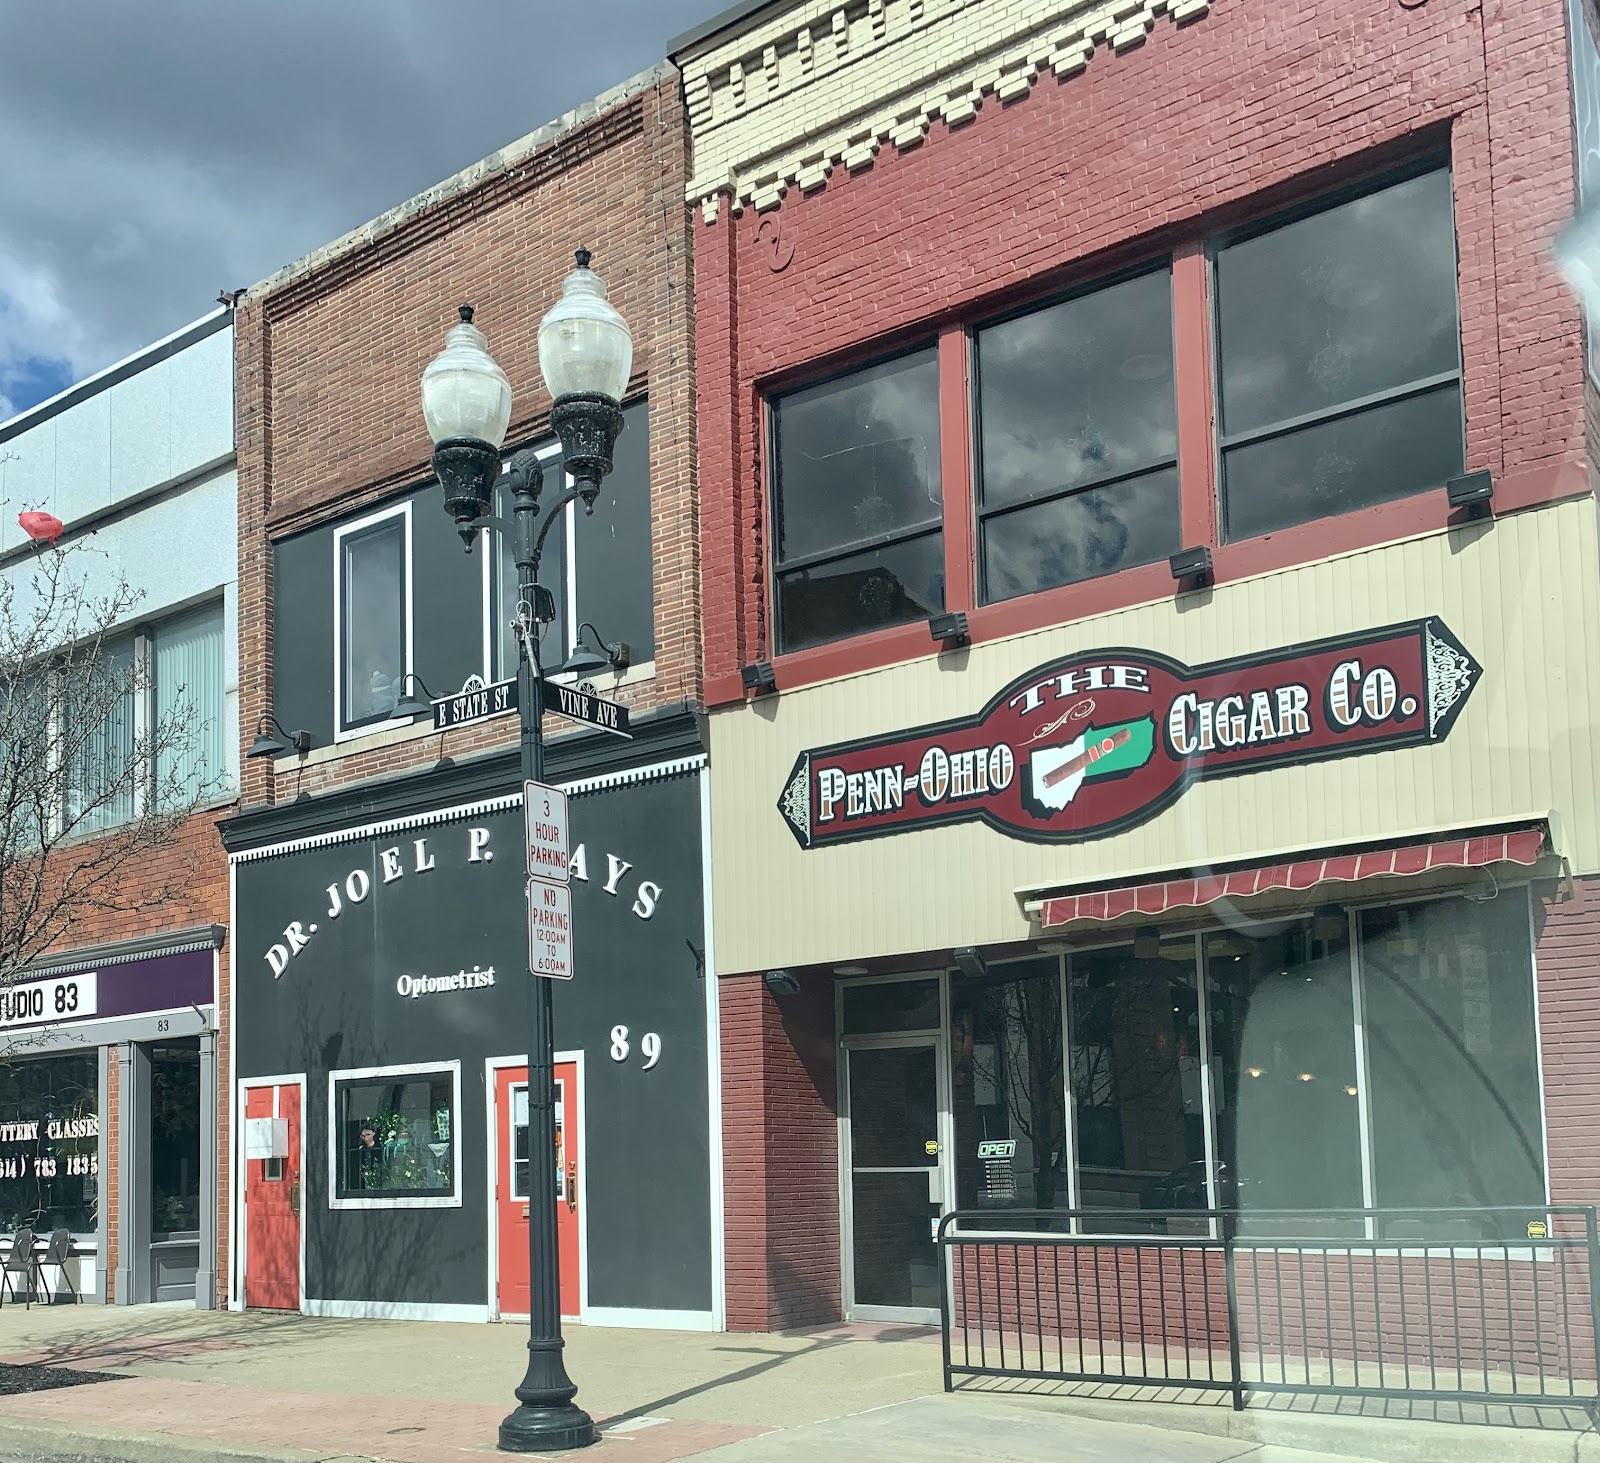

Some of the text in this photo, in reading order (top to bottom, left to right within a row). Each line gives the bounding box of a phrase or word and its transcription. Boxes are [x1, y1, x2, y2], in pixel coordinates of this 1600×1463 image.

[1009, 665, 1151, 716] THE
[439, 686, 509, 727] E STATE ST
[559, 689, 618, 729] VINE AVE
[818, 659, 1417, 821] PENN-OHIO CIGAR CO.
[543, 800, 551, 817] 3
[535, 821, 560, 844] HOUR
[530, 844, 567, 869] PARKING
[263, 827, 663, 980] DR. JOEL P. AYS
[544, 888, 556, 907] NO
[533, 908, 568, 931] PARKING
[536, 929, 566, 945] 12:00AM
[546, 944, 556, 957] TO
[538, 957, 566, 972] 6:00AM
[397, 966, 496, 999] Optometrist
[55, 983, 78, 1013] 83
[157, 1020, 169, 1033] 83
[0, 1118, 99, 1142] TTERY CLASSES
[979, 1142, 1014, 1157] OPEN
[34, 1159, 57, 1177] 783
[66, 1156, 98, 1176] 1835
